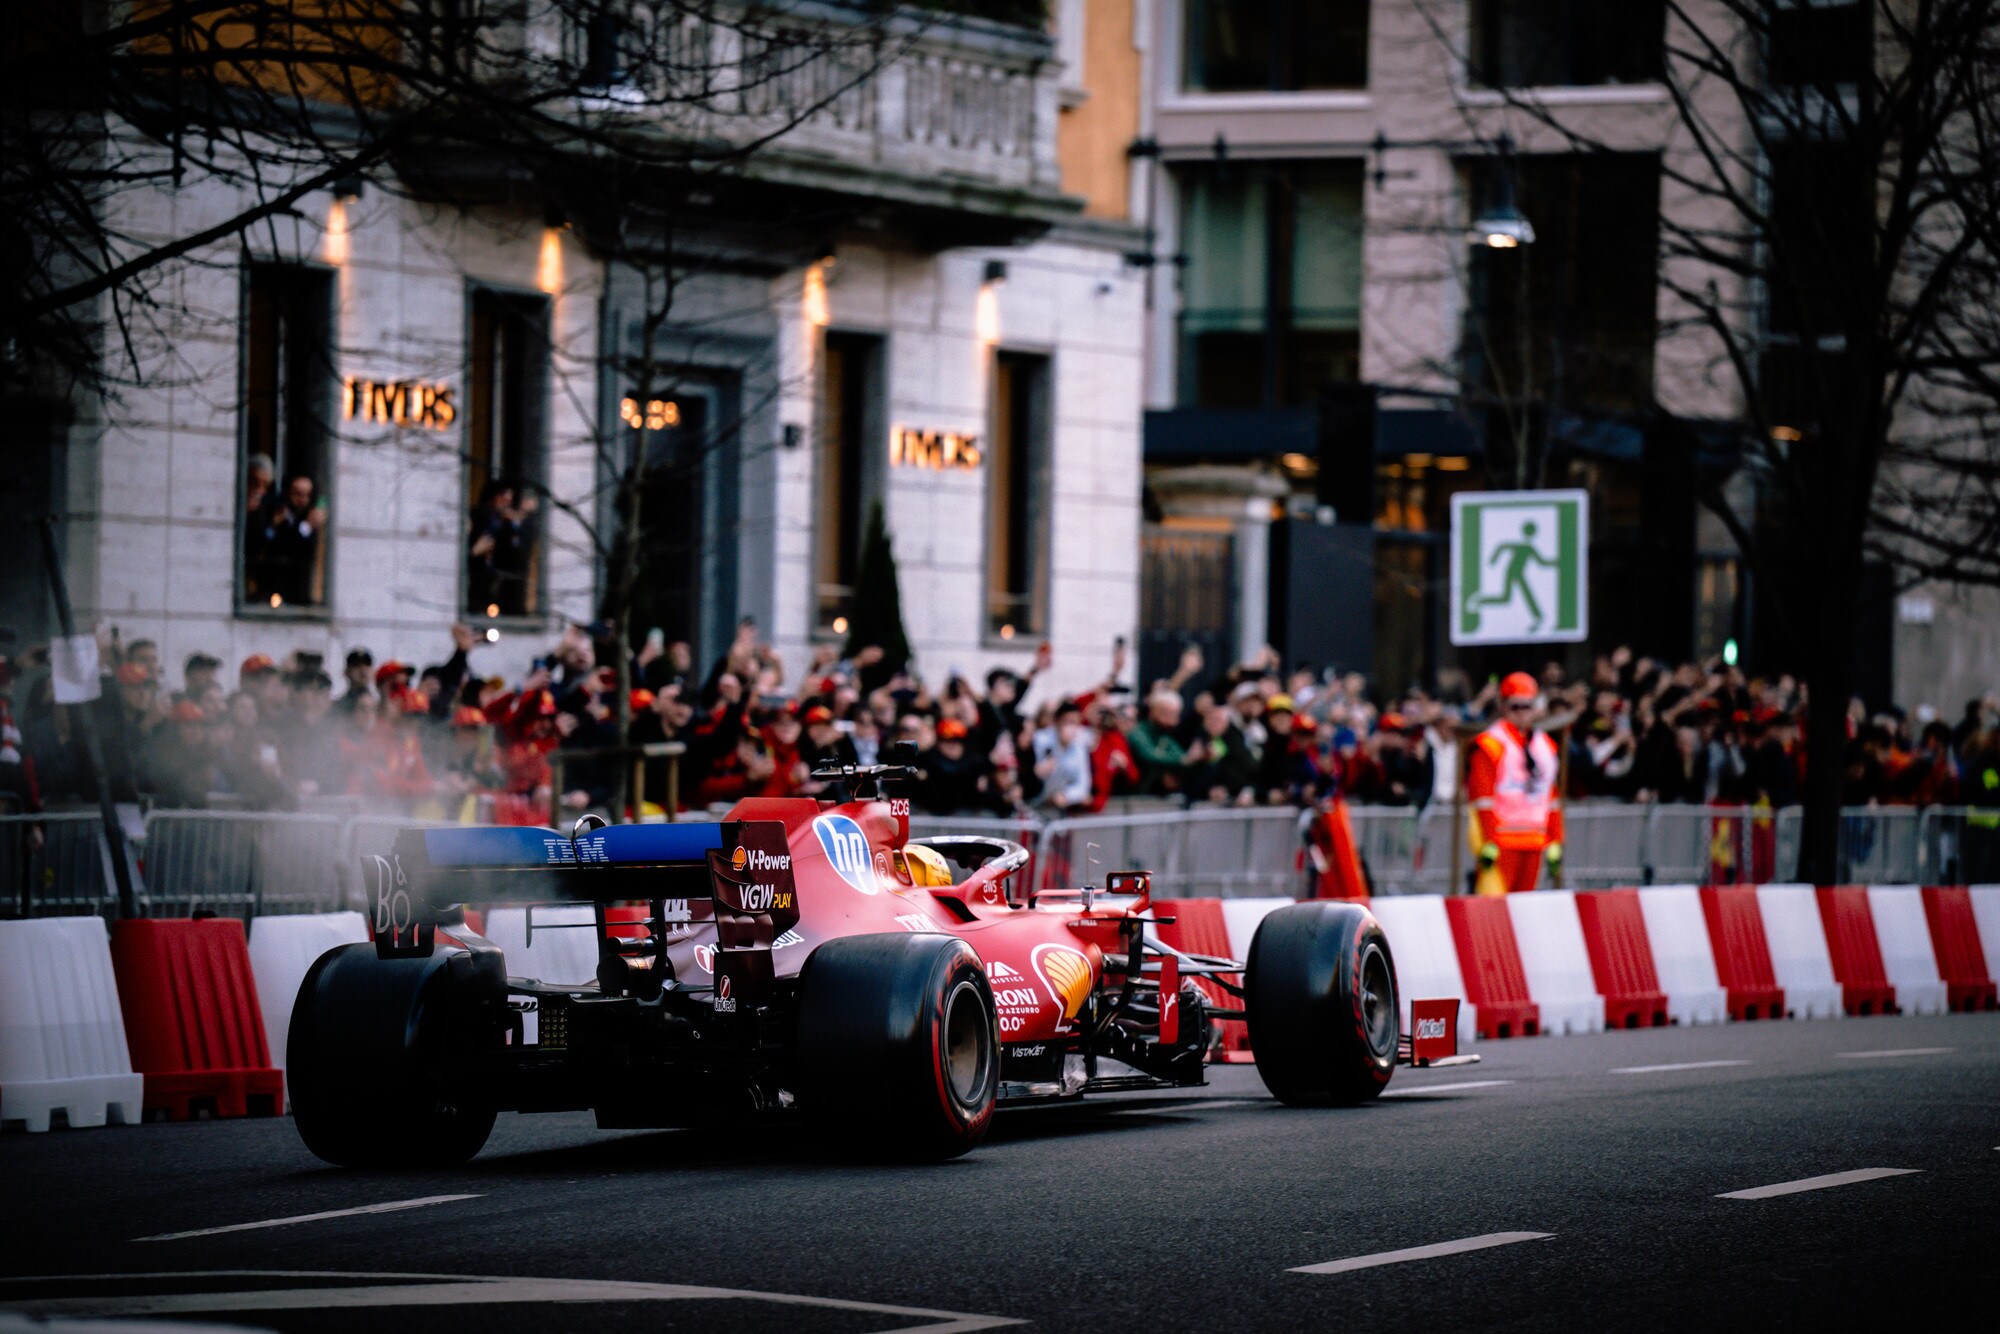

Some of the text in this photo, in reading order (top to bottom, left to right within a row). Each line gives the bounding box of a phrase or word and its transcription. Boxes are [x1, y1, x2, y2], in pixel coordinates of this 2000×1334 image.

[891, 800, 909, 816] ZCG
[543, 837, 610, 864] IBM
[747, 849, 791, 870] V-Power
[824, 817, 868, 892] hp
[983, 880, 997, 893] aws
[739, 884, 792, 910] VGW PLAY
[990, 975, 1025, 985] GISTICS
[993, 987, 1039, 1007] RONI
[1005, 1006, 1040, 1015] AZZURRO
